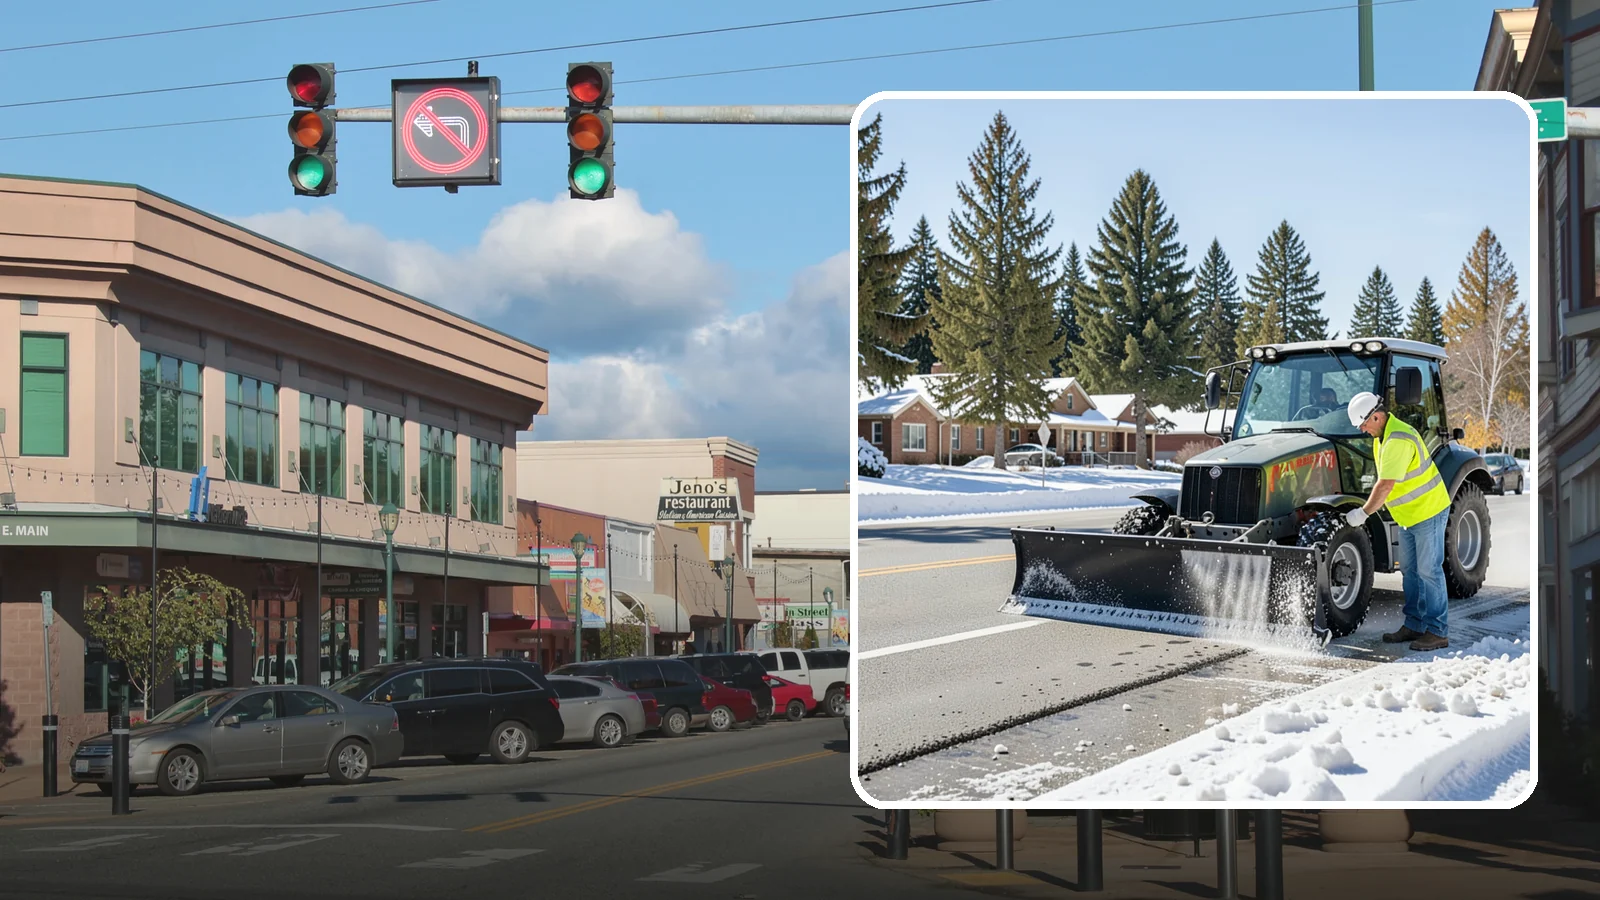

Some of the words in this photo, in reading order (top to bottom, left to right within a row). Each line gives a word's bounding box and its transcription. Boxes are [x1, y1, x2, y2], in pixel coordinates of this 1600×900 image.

[670, 480, 727, 494] Jeno's
[665, 496, 731, 509] restaurant
[659, 510, 682, 519] Italian
[686, 510, 714, 519] American
[715, 509, 737, 519] Cuisine
[2, 525, 13, 536] E.
[15, 525, 49, 536] MAIN
[797, 607, 828, 616] Street
